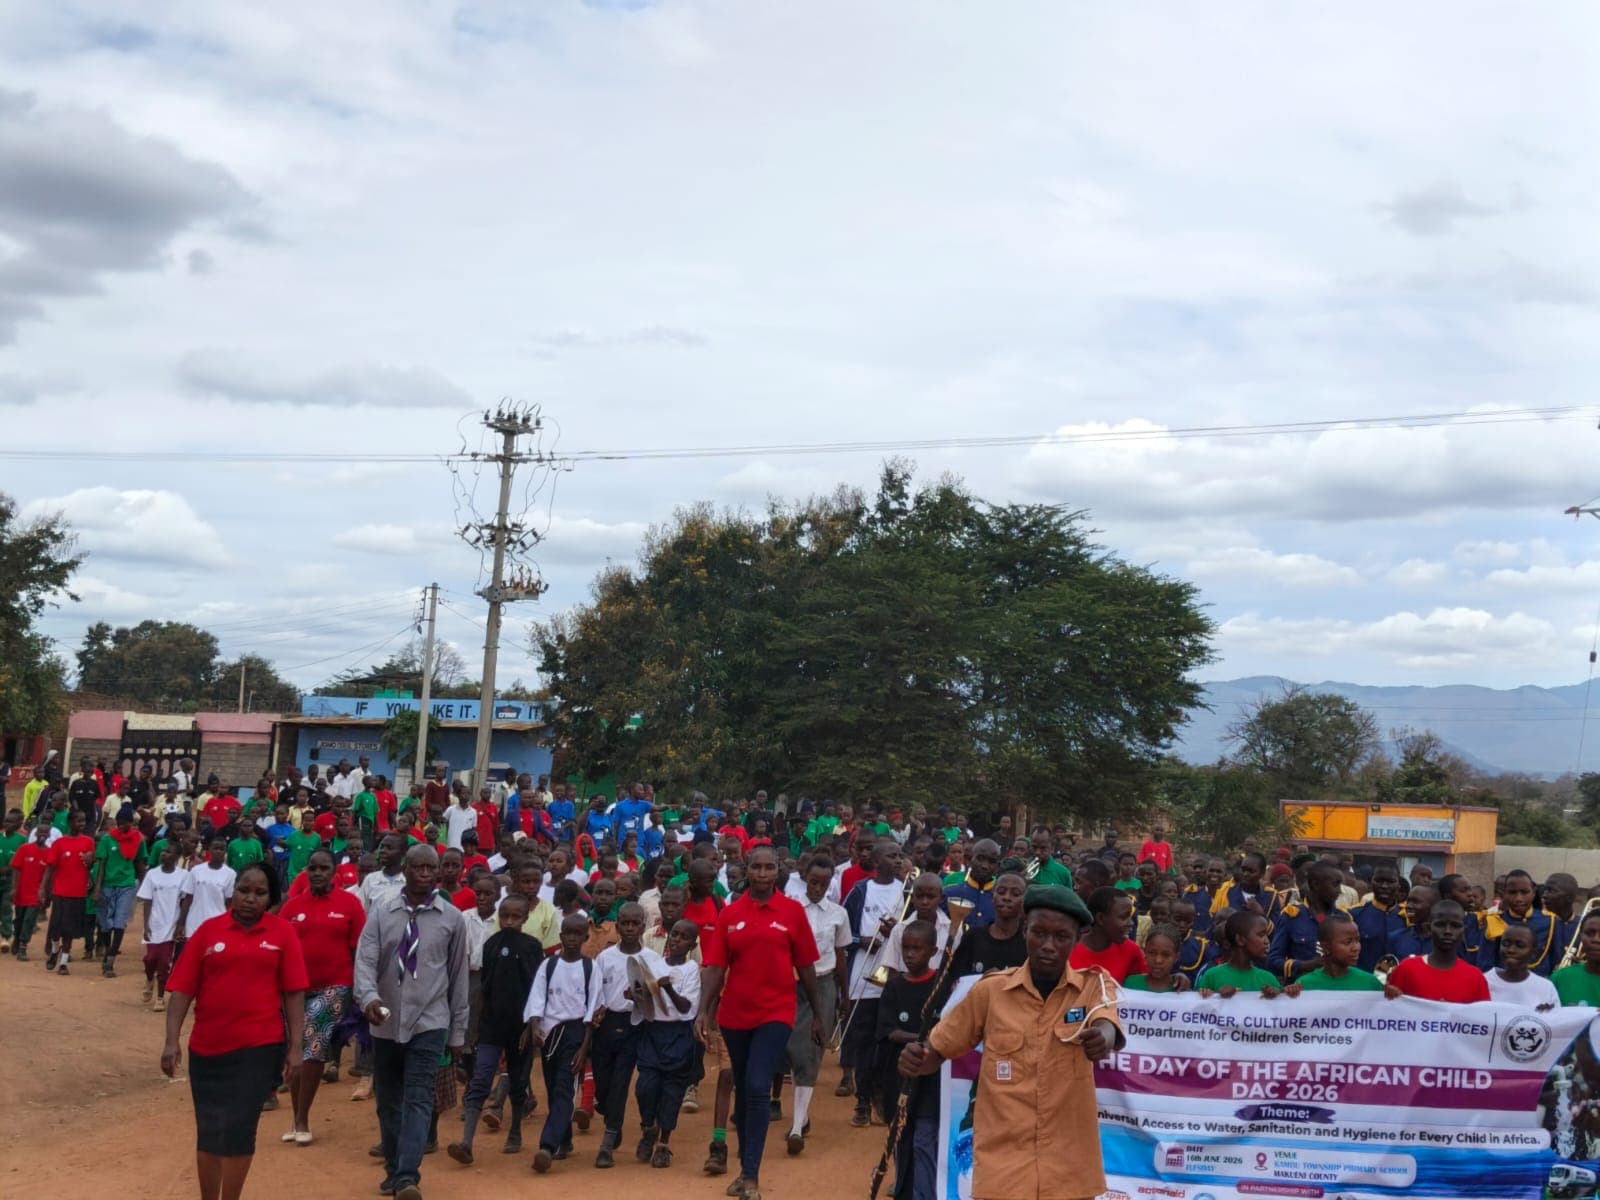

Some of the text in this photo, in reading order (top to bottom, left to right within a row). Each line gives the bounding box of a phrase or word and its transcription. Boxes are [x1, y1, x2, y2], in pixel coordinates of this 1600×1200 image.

[355, 702, 368, 715] IF
[386, 703, 411, 716] YOU
[432, 704, 453, 718] IKE
[460, 704, 476, 718] IT.
[1370, 828, 1454, 839] ELECTRONICS
[1117, 1008, 1489, 1036] ISTRY OF GENDER, CULTURE AND CHILDREN SERVICES
[1128, 1024, 1352, 1045] Department for Children Services
[1099, 1053, 1492, 1090] HE DAY OF THE AFRICAN CHILD
[1232, 1082, 1338, 1101] DAC 2026
[1259, 1106, 1310, 1119] Theme:
[1098, 1109, 1541, 1145] niversal Access to Water, Sanitation and Hygiene for Every Child in Africa.
[1203, 1155, 1220, 1163] JUNE
[1223, 1156, 1243, 1164] 2026
[1274, 1151, 1297, 1159] VENUE
[1303, 1162, 1341, 1171] TOWNSHIP
[1273, 1170, 1338, 1181] MAKUENI COUNTY
[1250, 1185, 1300, 1194] PARTNERSHIP
[1302, 1187, 1320, 1195] WITH
